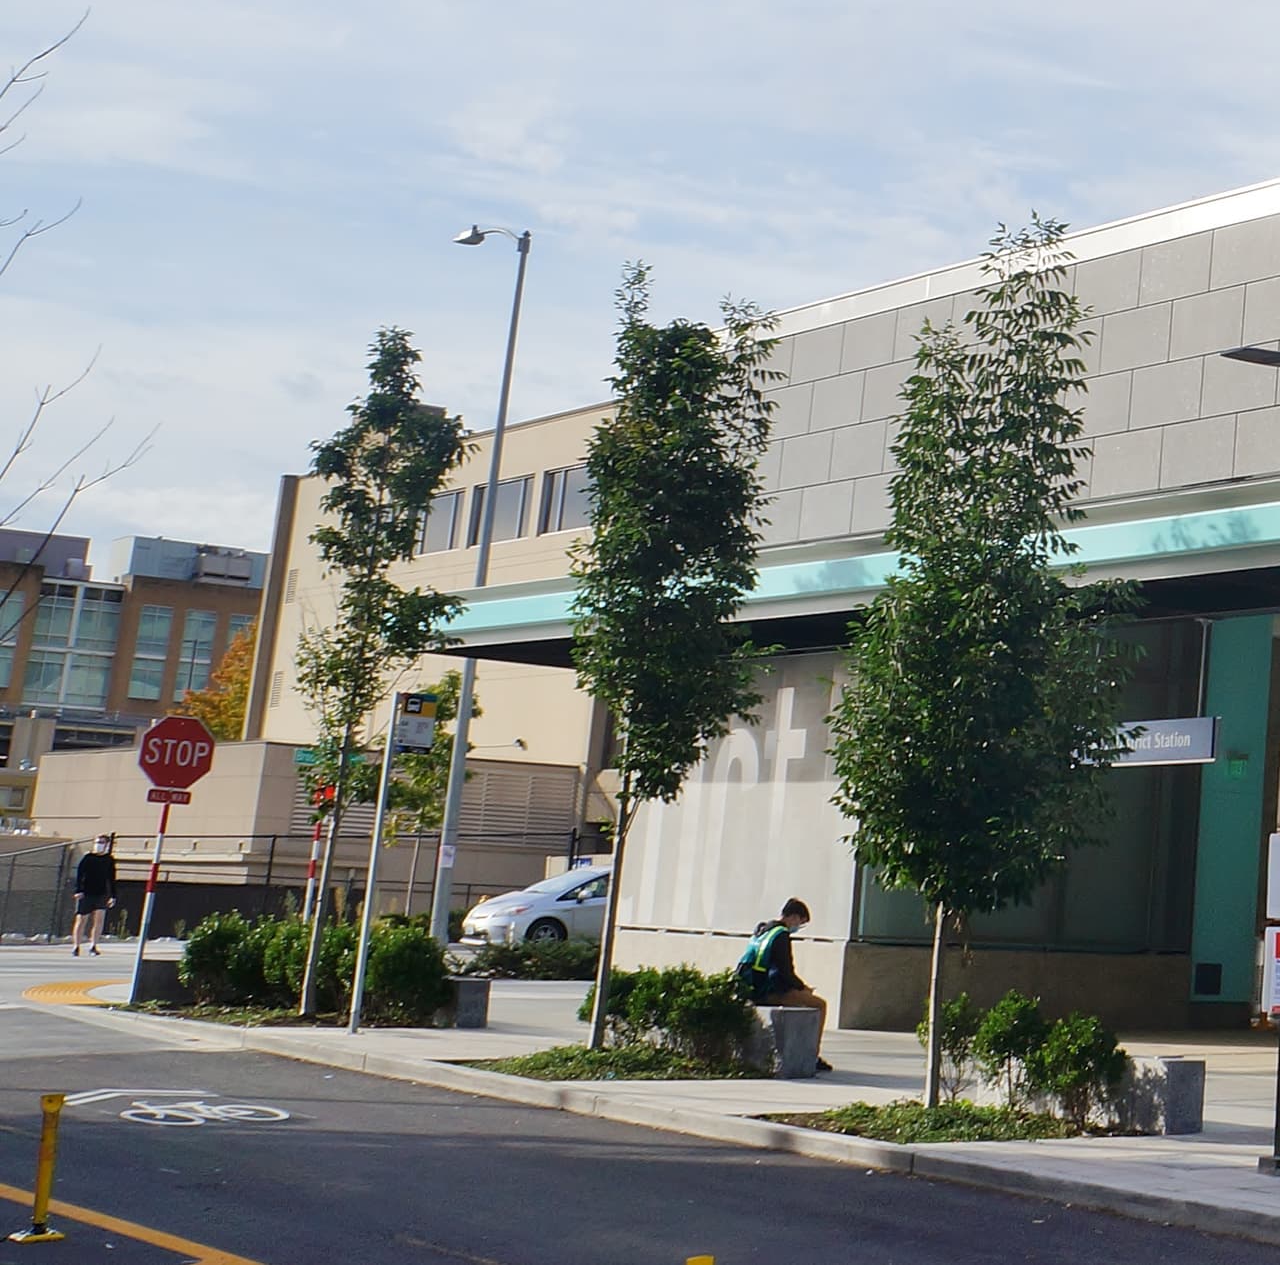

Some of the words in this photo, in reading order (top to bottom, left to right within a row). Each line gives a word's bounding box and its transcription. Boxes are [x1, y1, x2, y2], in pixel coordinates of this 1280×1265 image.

[1154, 731, 1191, 749] Station
[144, 738, 210, 767] STOP
[150, 790, 167, 801] ALL
[171, 792, 190, 803] WAY
